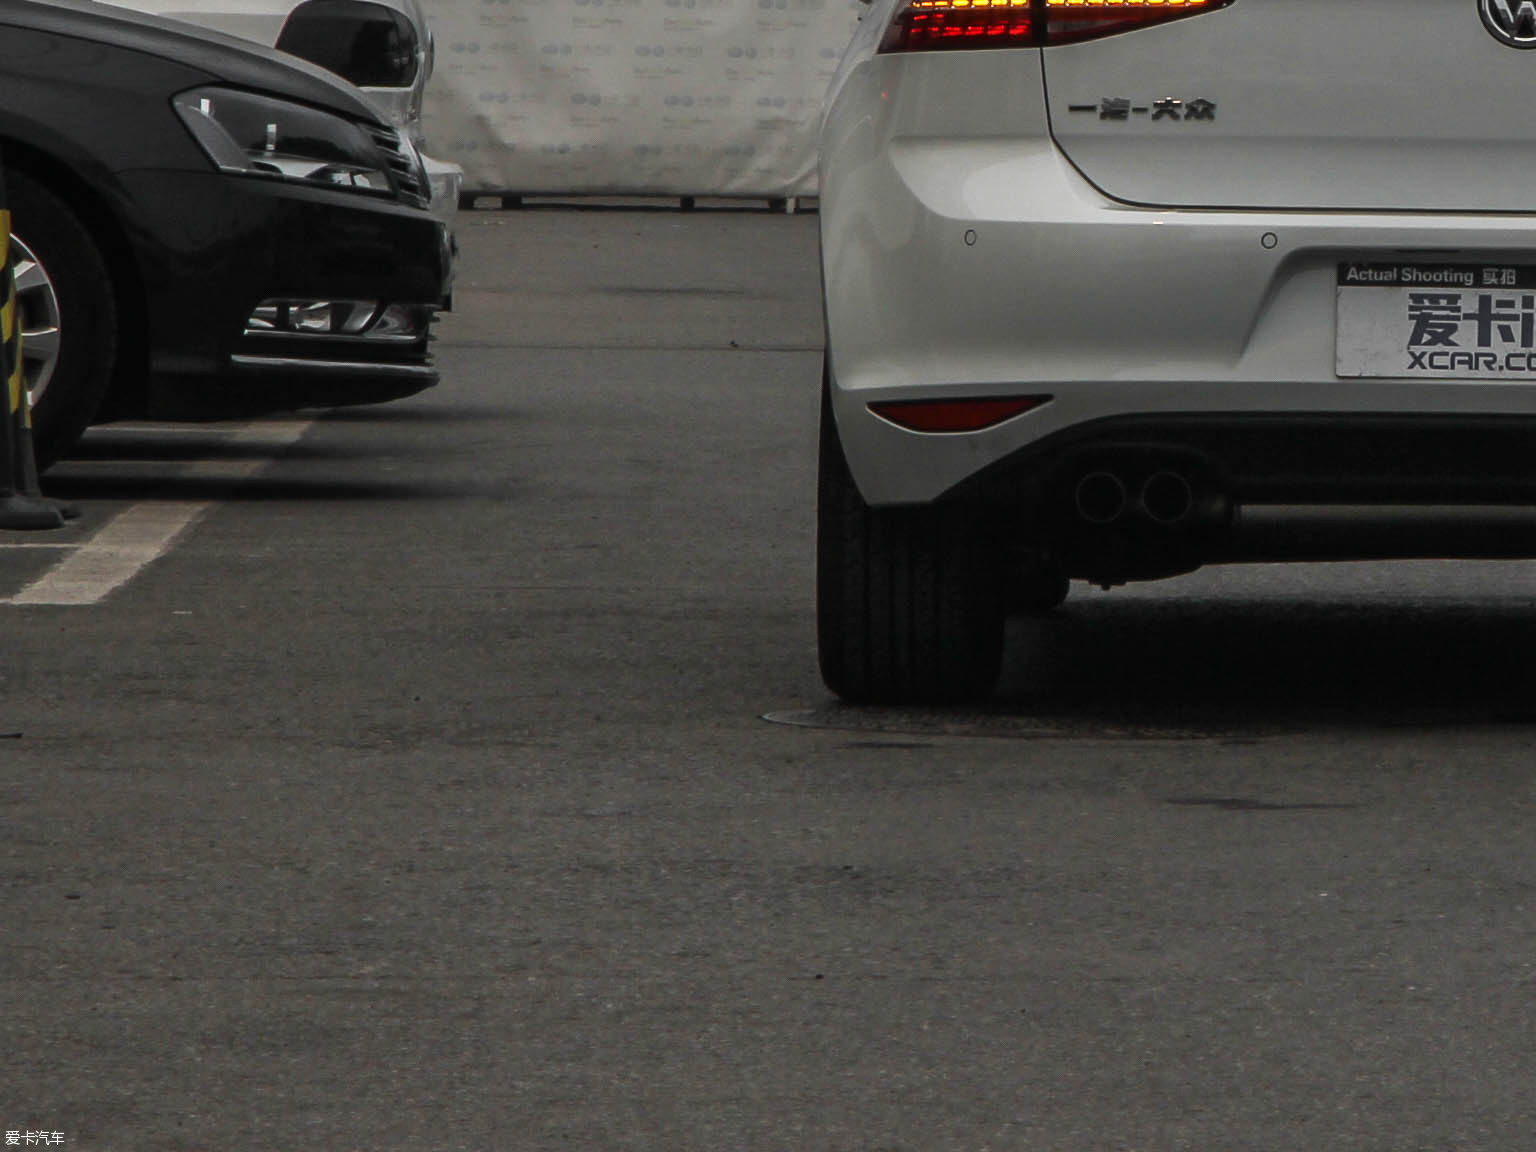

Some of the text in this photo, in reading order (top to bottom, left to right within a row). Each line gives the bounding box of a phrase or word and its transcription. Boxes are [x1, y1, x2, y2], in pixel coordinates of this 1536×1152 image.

[1346, 267, 1517, 286] Actual Shooting 实拍
